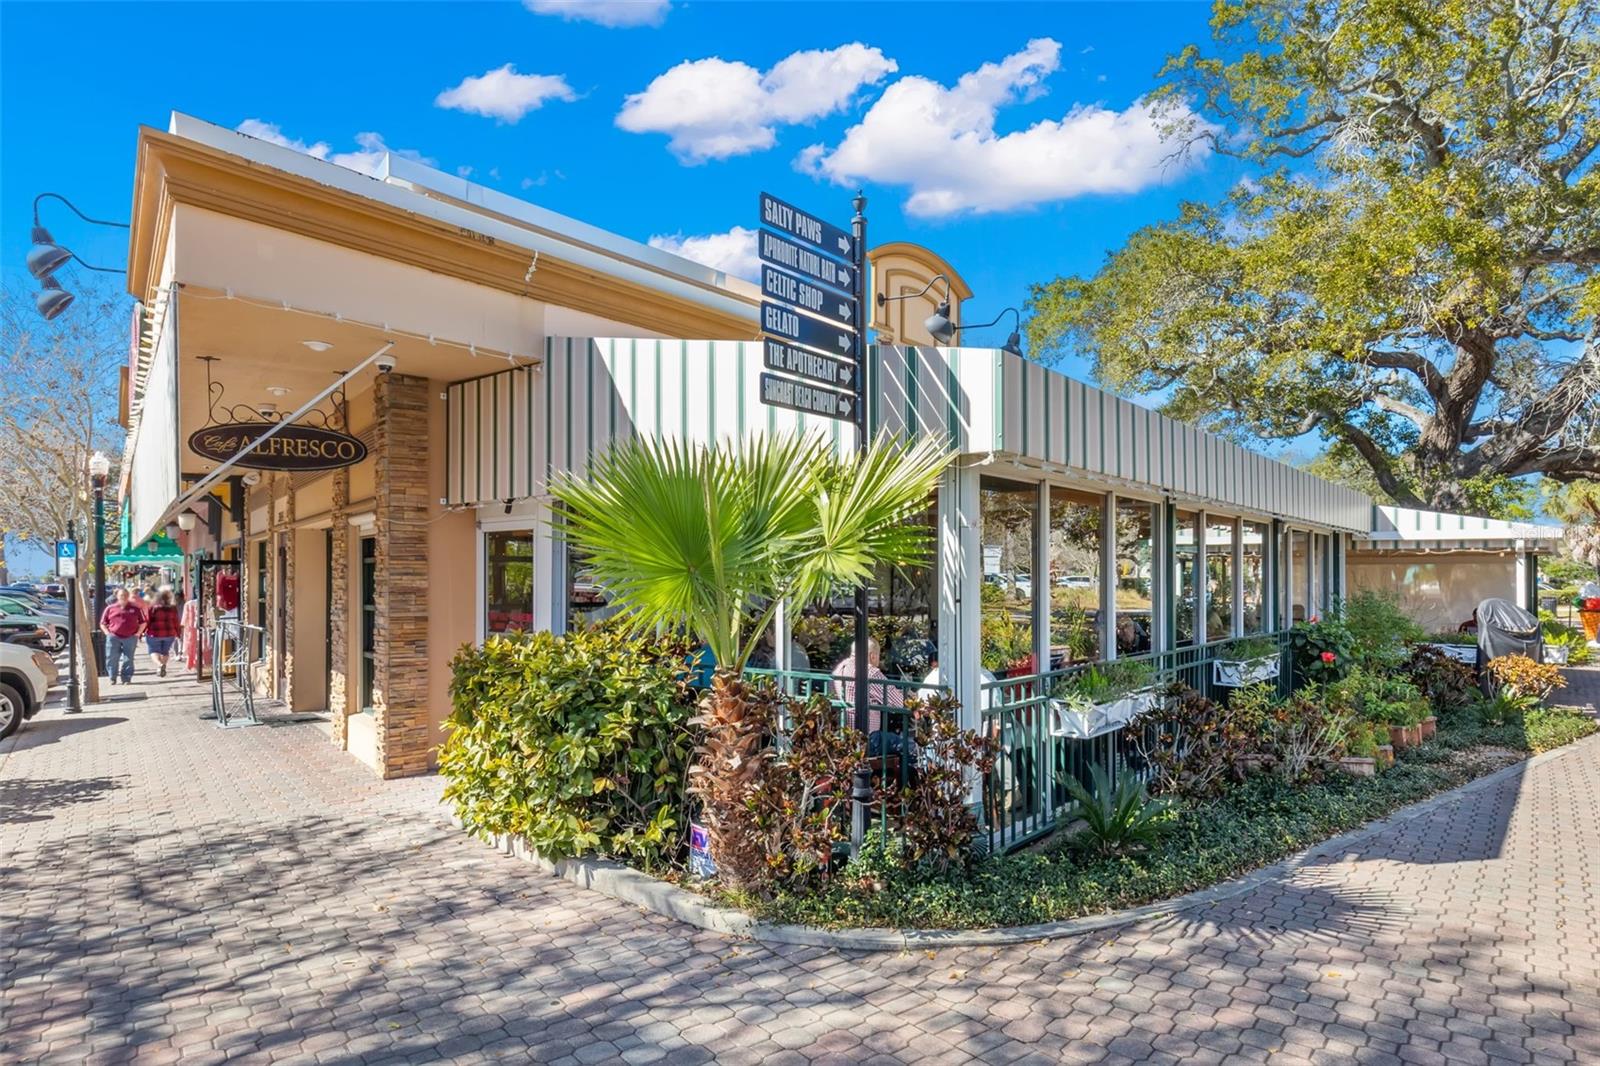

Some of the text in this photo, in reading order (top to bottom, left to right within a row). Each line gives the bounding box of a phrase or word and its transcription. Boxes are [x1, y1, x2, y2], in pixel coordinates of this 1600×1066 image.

[765, 198, 822, 244] SALTY PAWS
[766, 269, 823, 311] CELTIC SHOP
[766, 306, 799, 338] GELATO
[769, 342, 838, 382] THE APOTHECARY
[795, 386, 811, 410] BEACH
[813, 390, 836, 415] COMPANY
[237, 436, 356, 460] ALFRESCO
